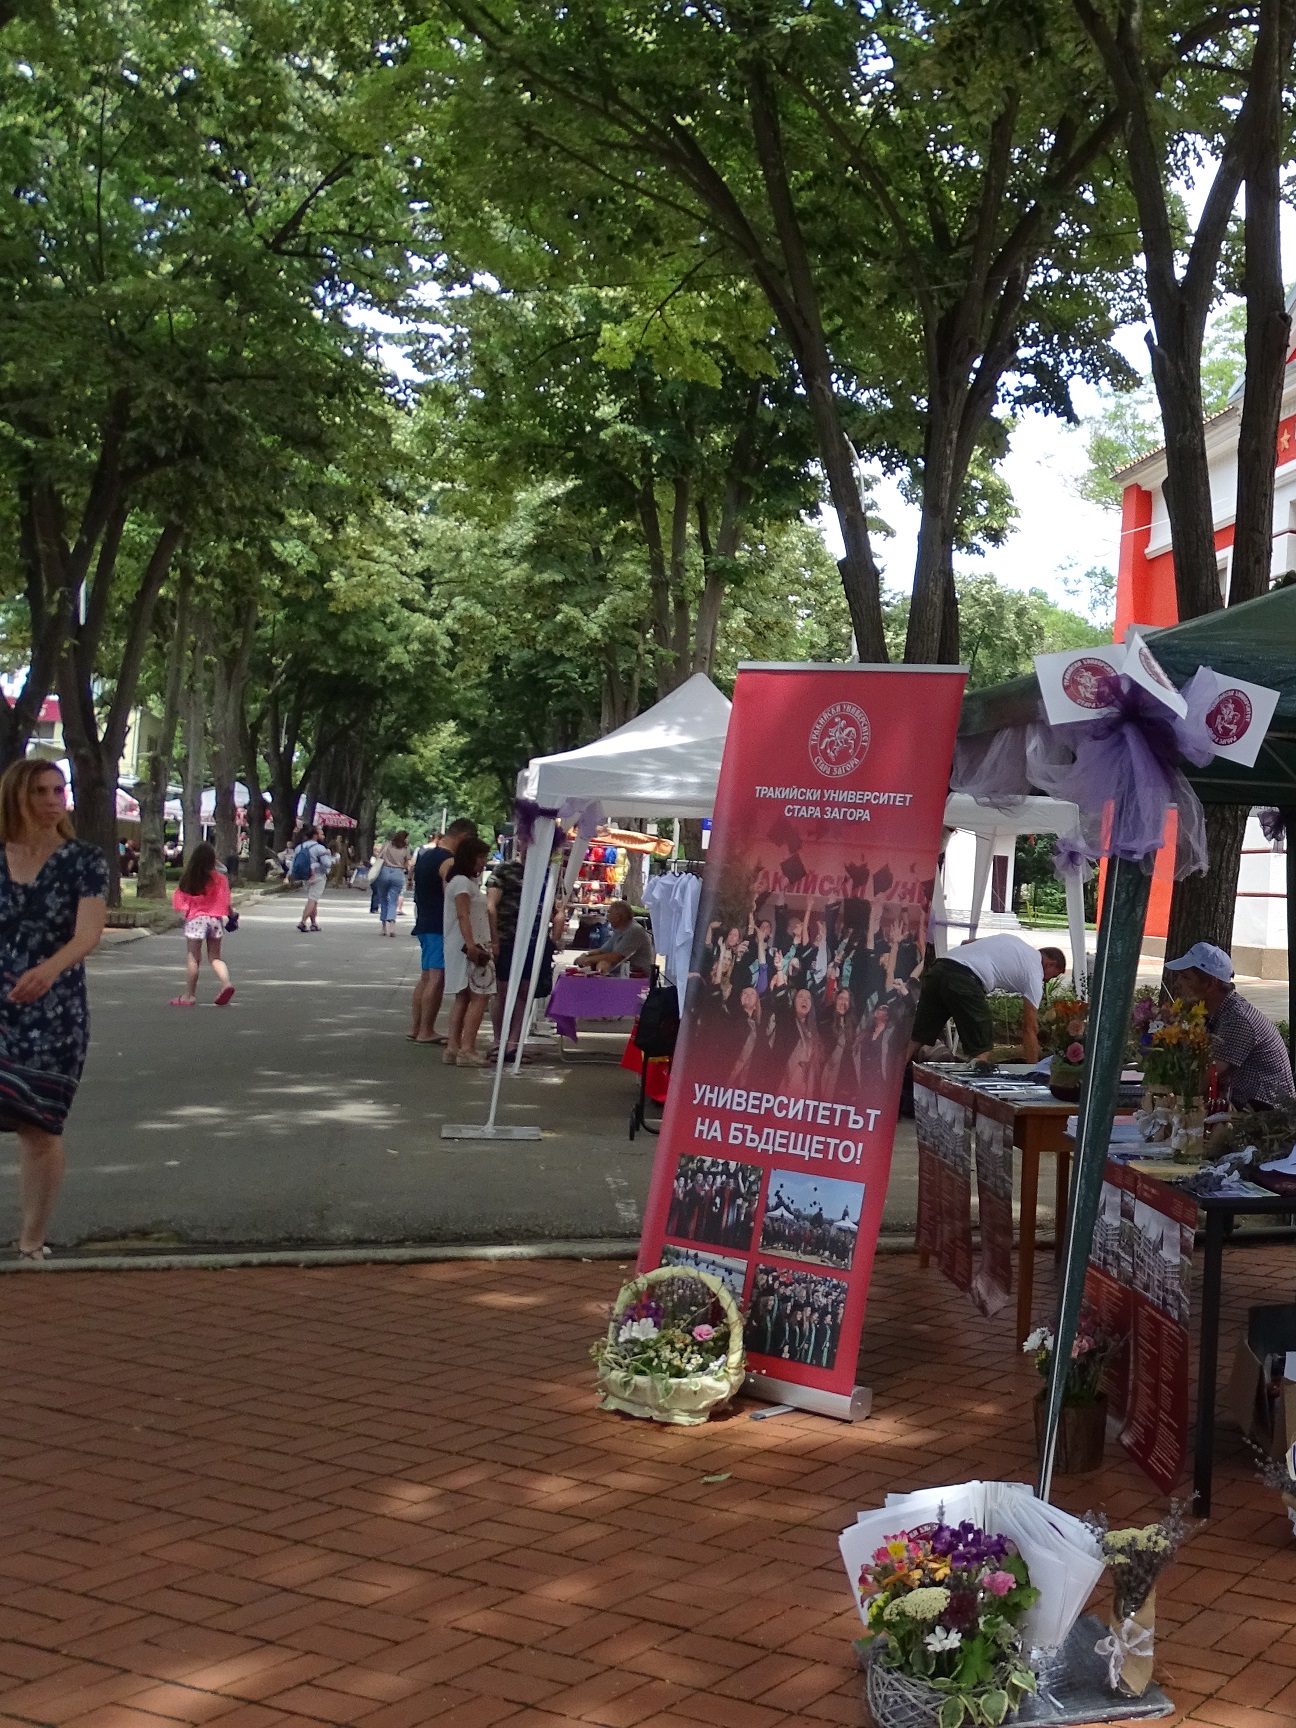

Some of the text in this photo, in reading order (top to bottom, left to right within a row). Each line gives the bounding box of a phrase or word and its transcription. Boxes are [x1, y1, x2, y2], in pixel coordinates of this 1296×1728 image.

[811, 704, 869, 746] ТРАКИЙСКИ УНИВЕРСИТЕТ
[814, 756, 860, 775] СТАРА ЗАГОРА
[755, 785, 913, 807] ТРАКИЙСКИ УНИВЕРСИТЕТ
[784, 804, 871, 822] СТАРА ЗАГОРА
[692, 1083, 881, 1132] УНИВЕРСИТЕТЪТ
[694, 1117, 864, 1165] НА БЪДЕЩЕТО!
